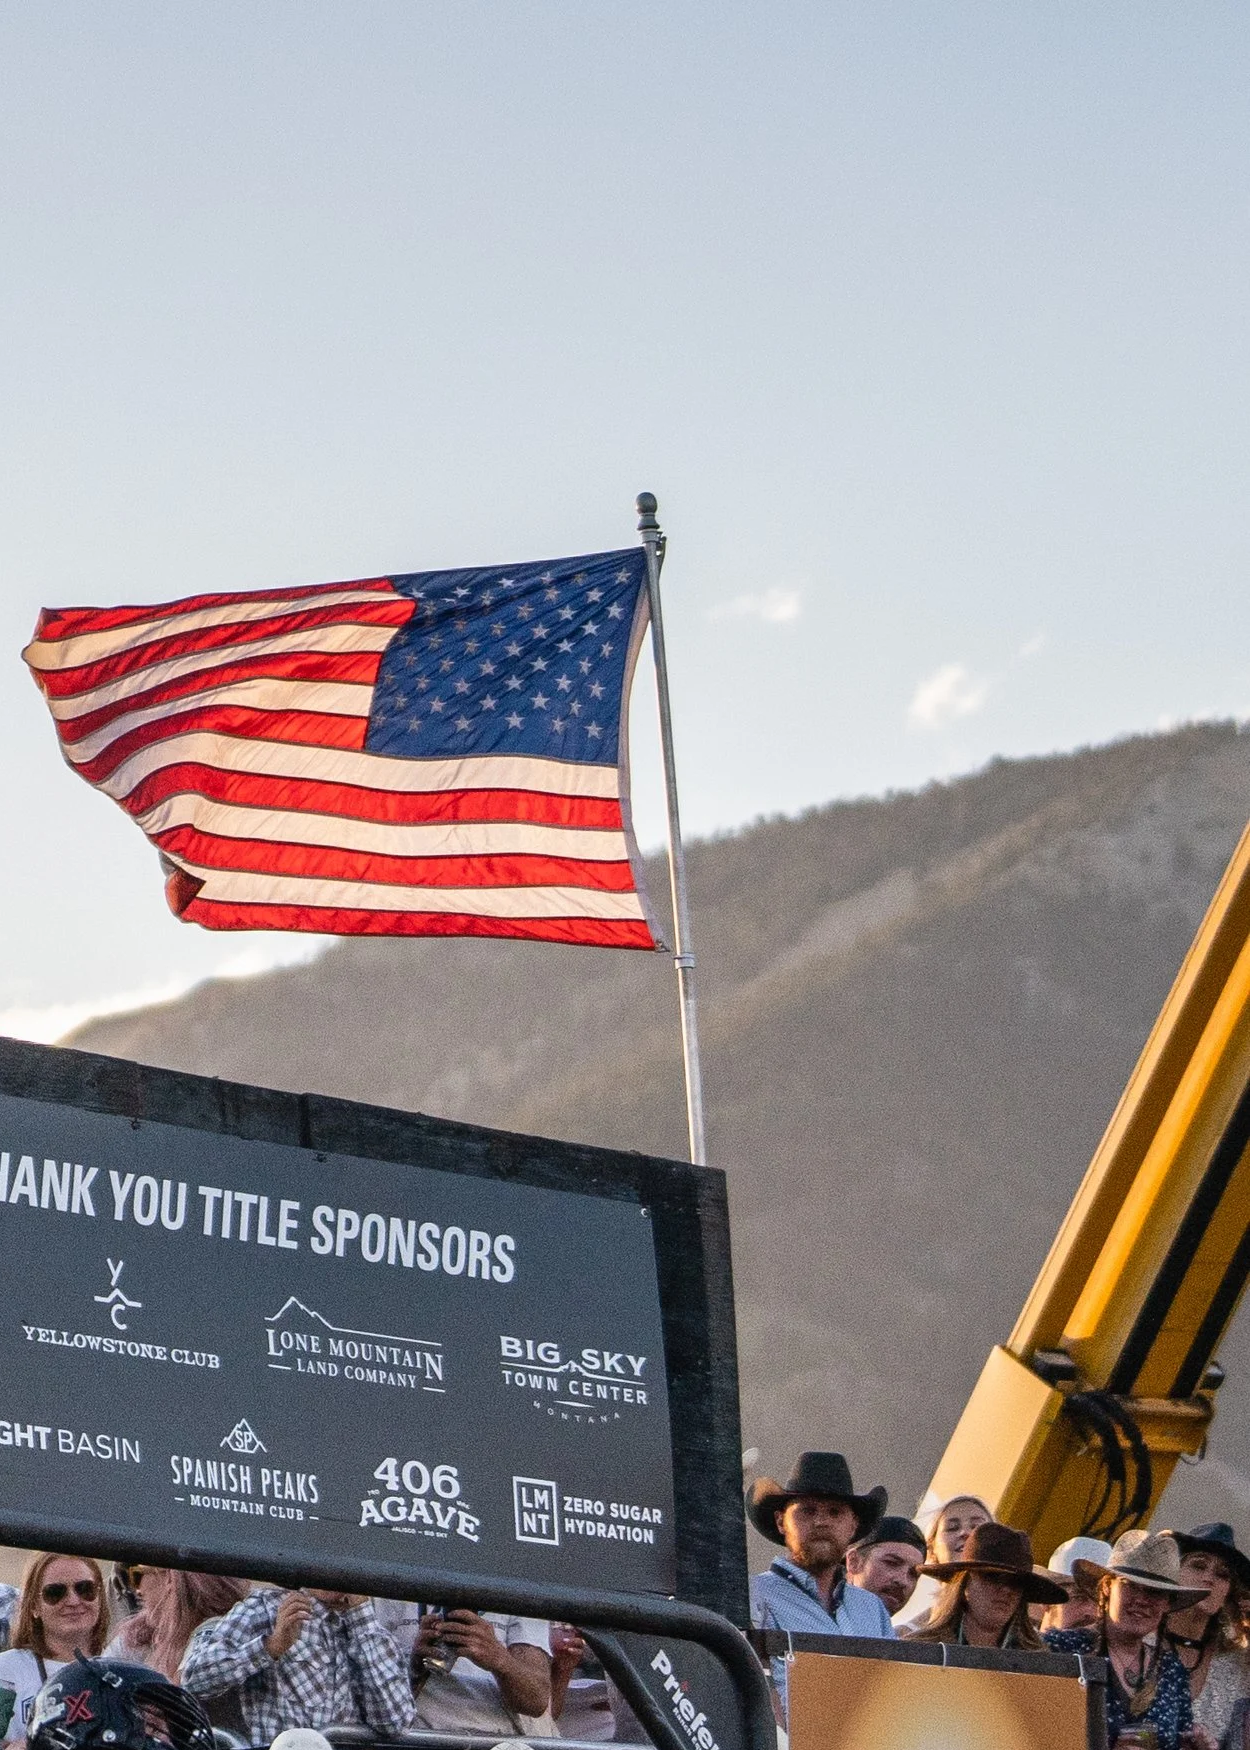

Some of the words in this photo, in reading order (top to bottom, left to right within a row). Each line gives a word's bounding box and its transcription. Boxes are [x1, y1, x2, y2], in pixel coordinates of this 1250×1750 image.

[108, 1169, 187, 1231] YOU
[198, 1185, 300, 1250] TITLE
[310, 1204, 515, 1283] SPONSORS
[21, 1324, 168, 1362] YELLOWSTONE
[170, 1347, 221, 1370] CLUB
[265, 1328, 322, 1357] LONE
[328, 1337, 444, 1382] MOUNTAIN
[499, 1335, 561, 1364] BIG
[580, 1348, 647, 1377] SKY
[296, 1357, 339, 1378] LAND
[344, 1364, 418, 1389] COMPANY
[501, 1369, 559, 1392] TOWN
[568, 1379, 649, 1406] CENTER
[533, 1401, 621, 1425] MONTANA
[57, 1428, 141, 1464] BASIN
[234, 1429, 254, 1451] SP
[170, 1454, 252, 1495] SPANISH
[260, 1467, 320, 1504] PEAKS
[372, 1456, 461, 1499] 406
[189, 1493, 265, 1516] MOUNTAIN
[268, 1504, 305, 1521] CLUB
[521, 1486, 550, 1511] LM
[563, 1495, 606, 1517] ZERO
[608, 1502, 663, 1525] SUGAR
[358, 1496, 481, 1543] AGAVE
[522, 1511, 550, 1535] NT
[564, 1517, 655, 1544] HYDRATION
